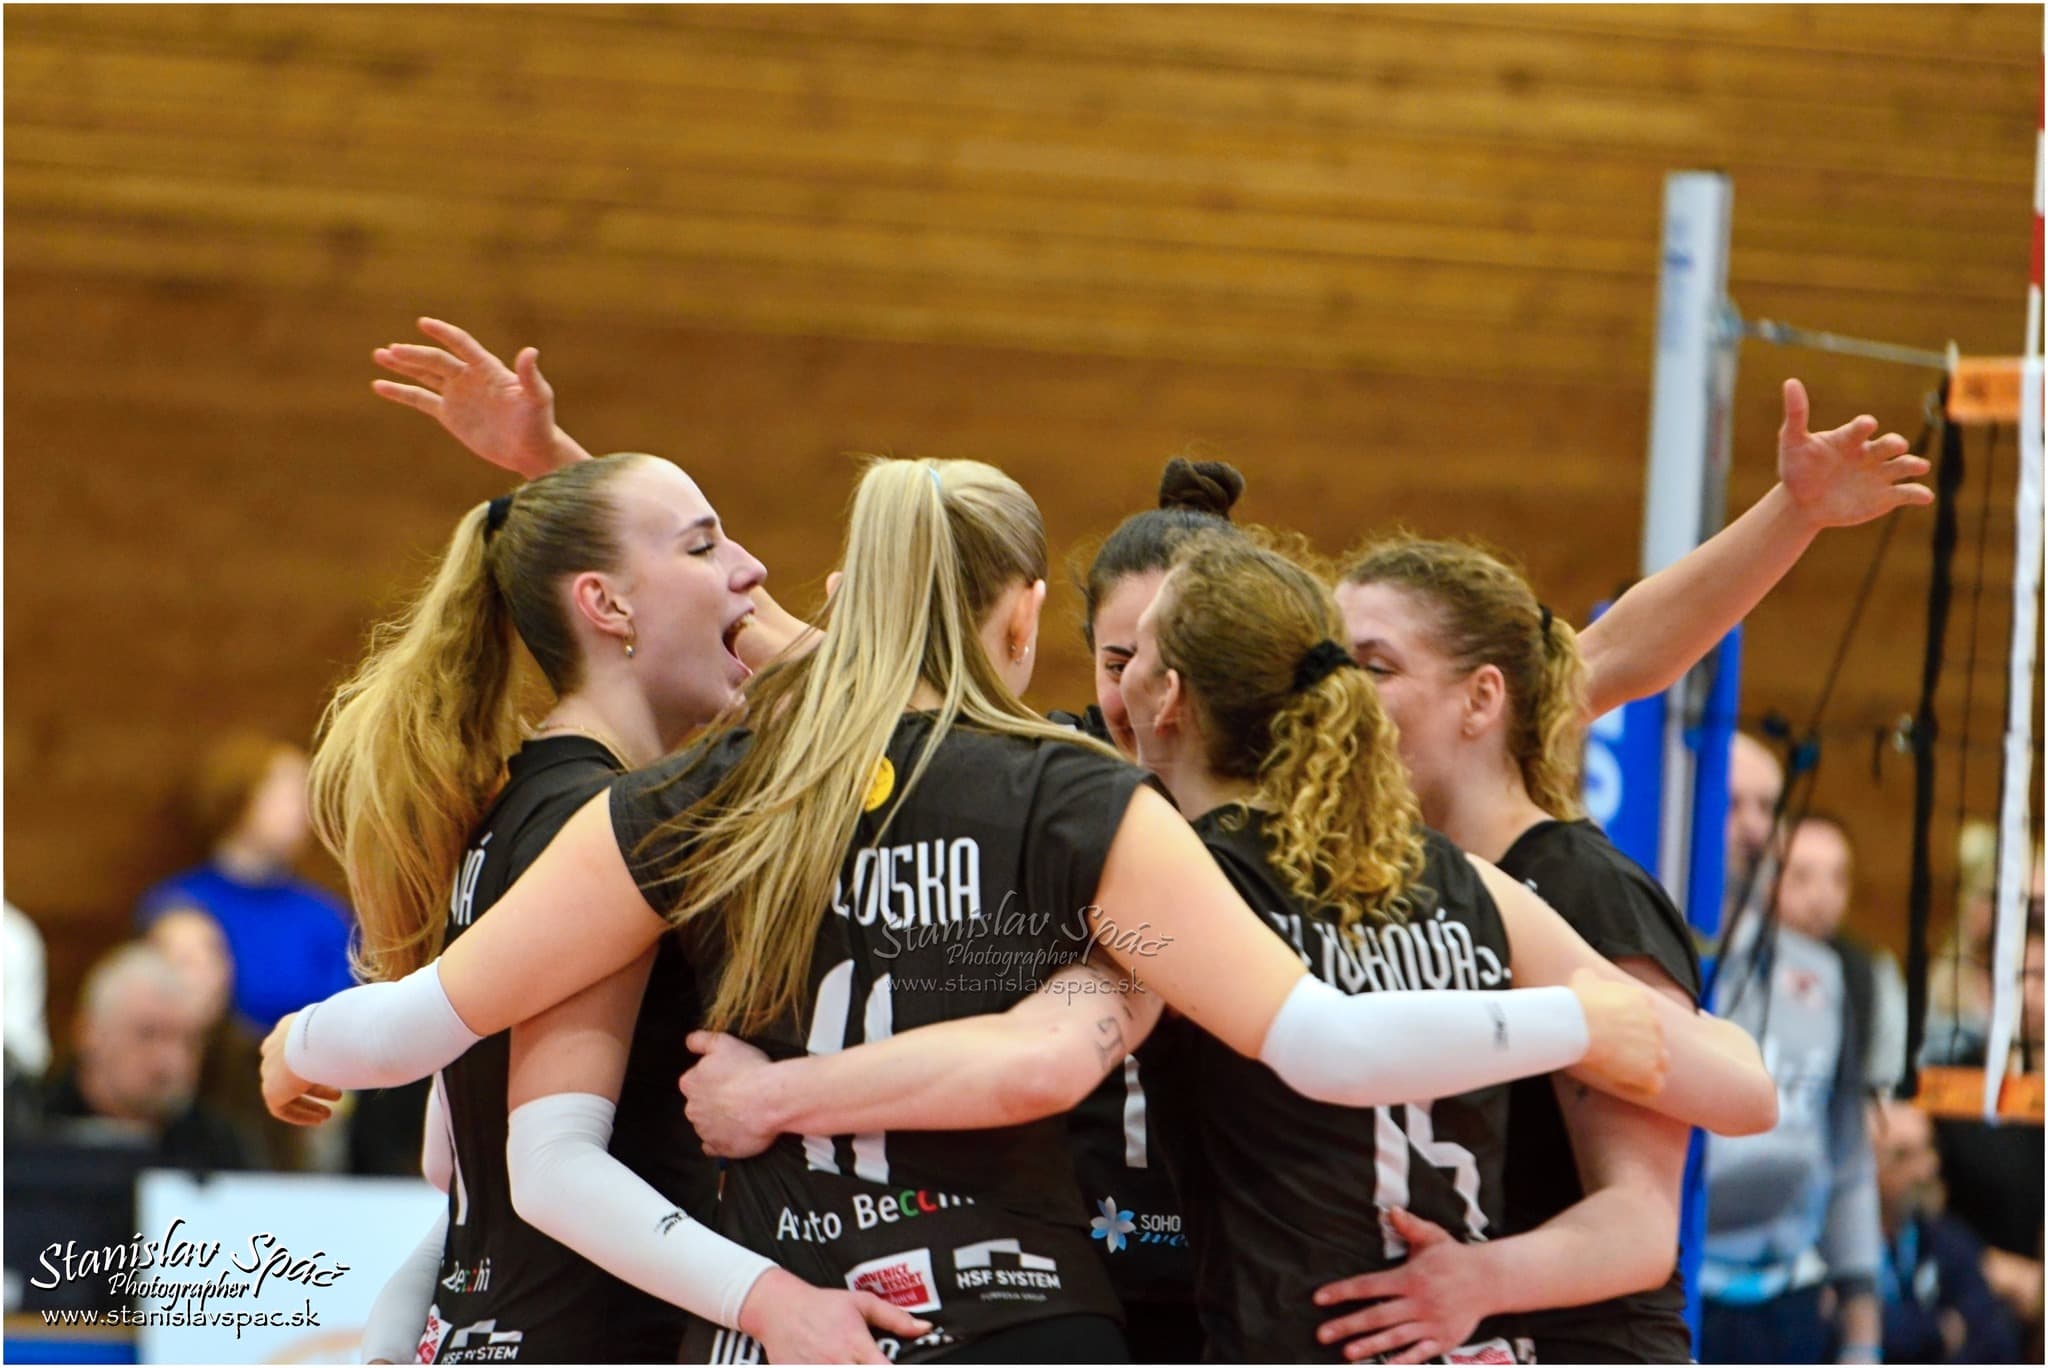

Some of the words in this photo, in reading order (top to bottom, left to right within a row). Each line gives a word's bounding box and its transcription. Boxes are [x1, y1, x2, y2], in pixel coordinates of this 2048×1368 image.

[1140, 1214, 1181, 1232] SOHO
[955, 1270, 994, 1290] HSF
[998, 1270, 1062, 1290] SYSTEM
